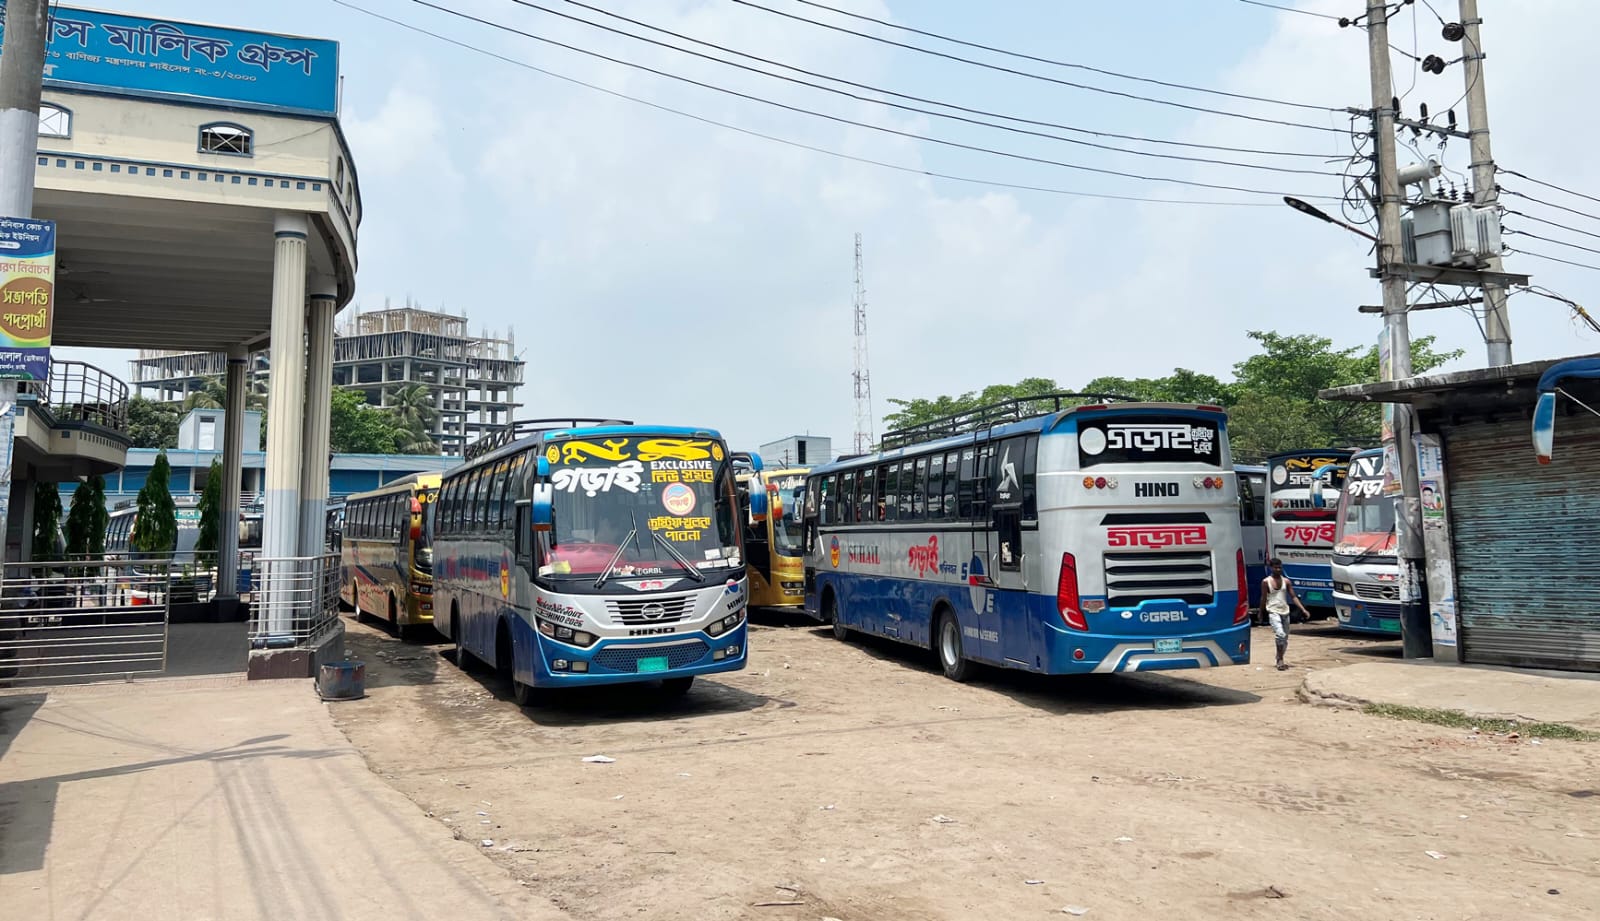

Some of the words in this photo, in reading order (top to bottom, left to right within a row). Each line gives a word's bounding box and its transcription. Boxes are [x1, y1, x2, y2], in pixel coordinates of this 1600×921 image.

[43, 14, 95, 47] াস
[101, 23, 233, 63] মালিক
[238, 42, 319, 75] গ্রুপ
[65, 51, 101, 63] বাণিজ্য
[3, 287, 49, 305] সভাপতি
[1107, 424, 1193, 452] গড়াই
[650, 460, 713, 470] EXCLUSIVE
[551, 459, 645, 498] গড়াই
[1135, 482, 1180, 497] HINO
[665, 530, 701, 542] পাবনা
[1107, 526, 1207, 549] গড়াই
[908, 534, 939, 578] গড়াই
[1149, 611, 1189, 622] GRBL
[629, 627, 676, 637] HINO
